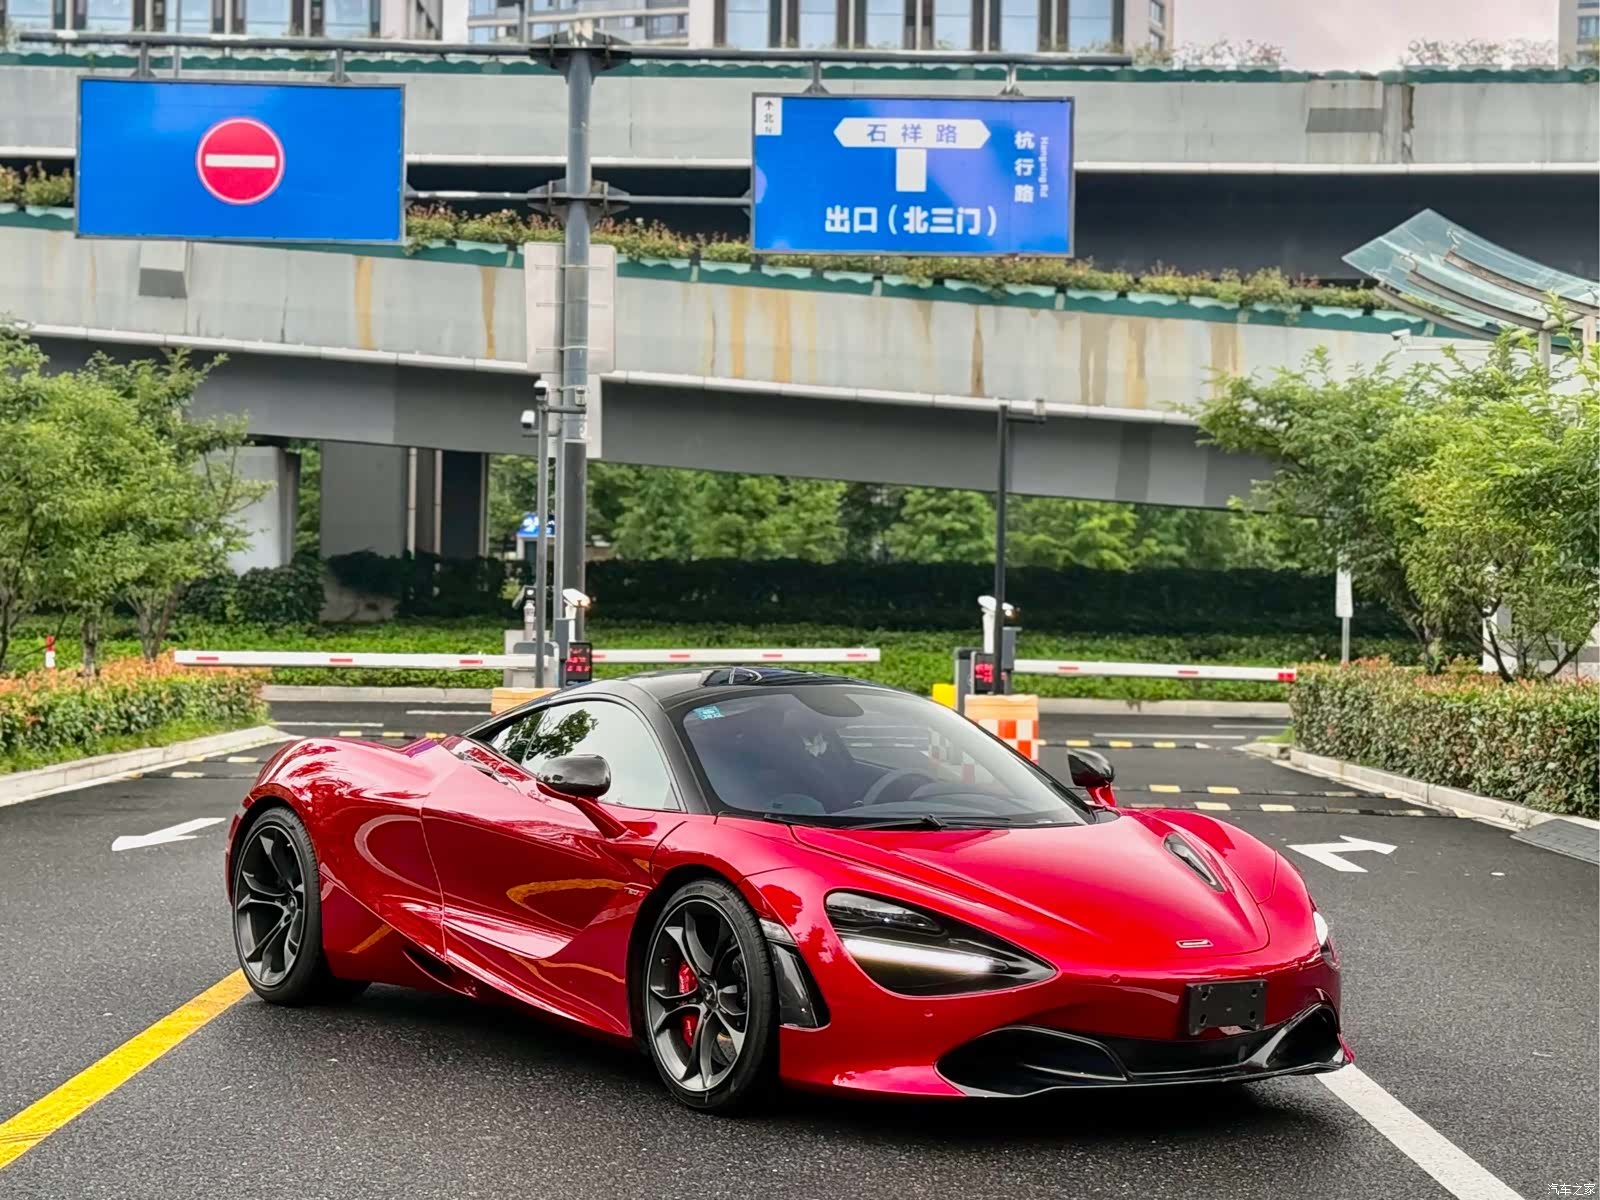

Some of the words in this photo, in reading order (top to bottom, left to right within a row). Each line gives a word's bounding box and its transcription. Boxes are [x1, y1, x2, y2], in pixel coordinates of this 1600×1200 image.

[763, 113, 774, 124] 北
[867, 123, 958, 144] 石祥路
[1014, 130, 1035, 204] 杭行路
[1038, 136, 1050, 183] Hangxing
[1039, 184, 1050, 198] Rd
